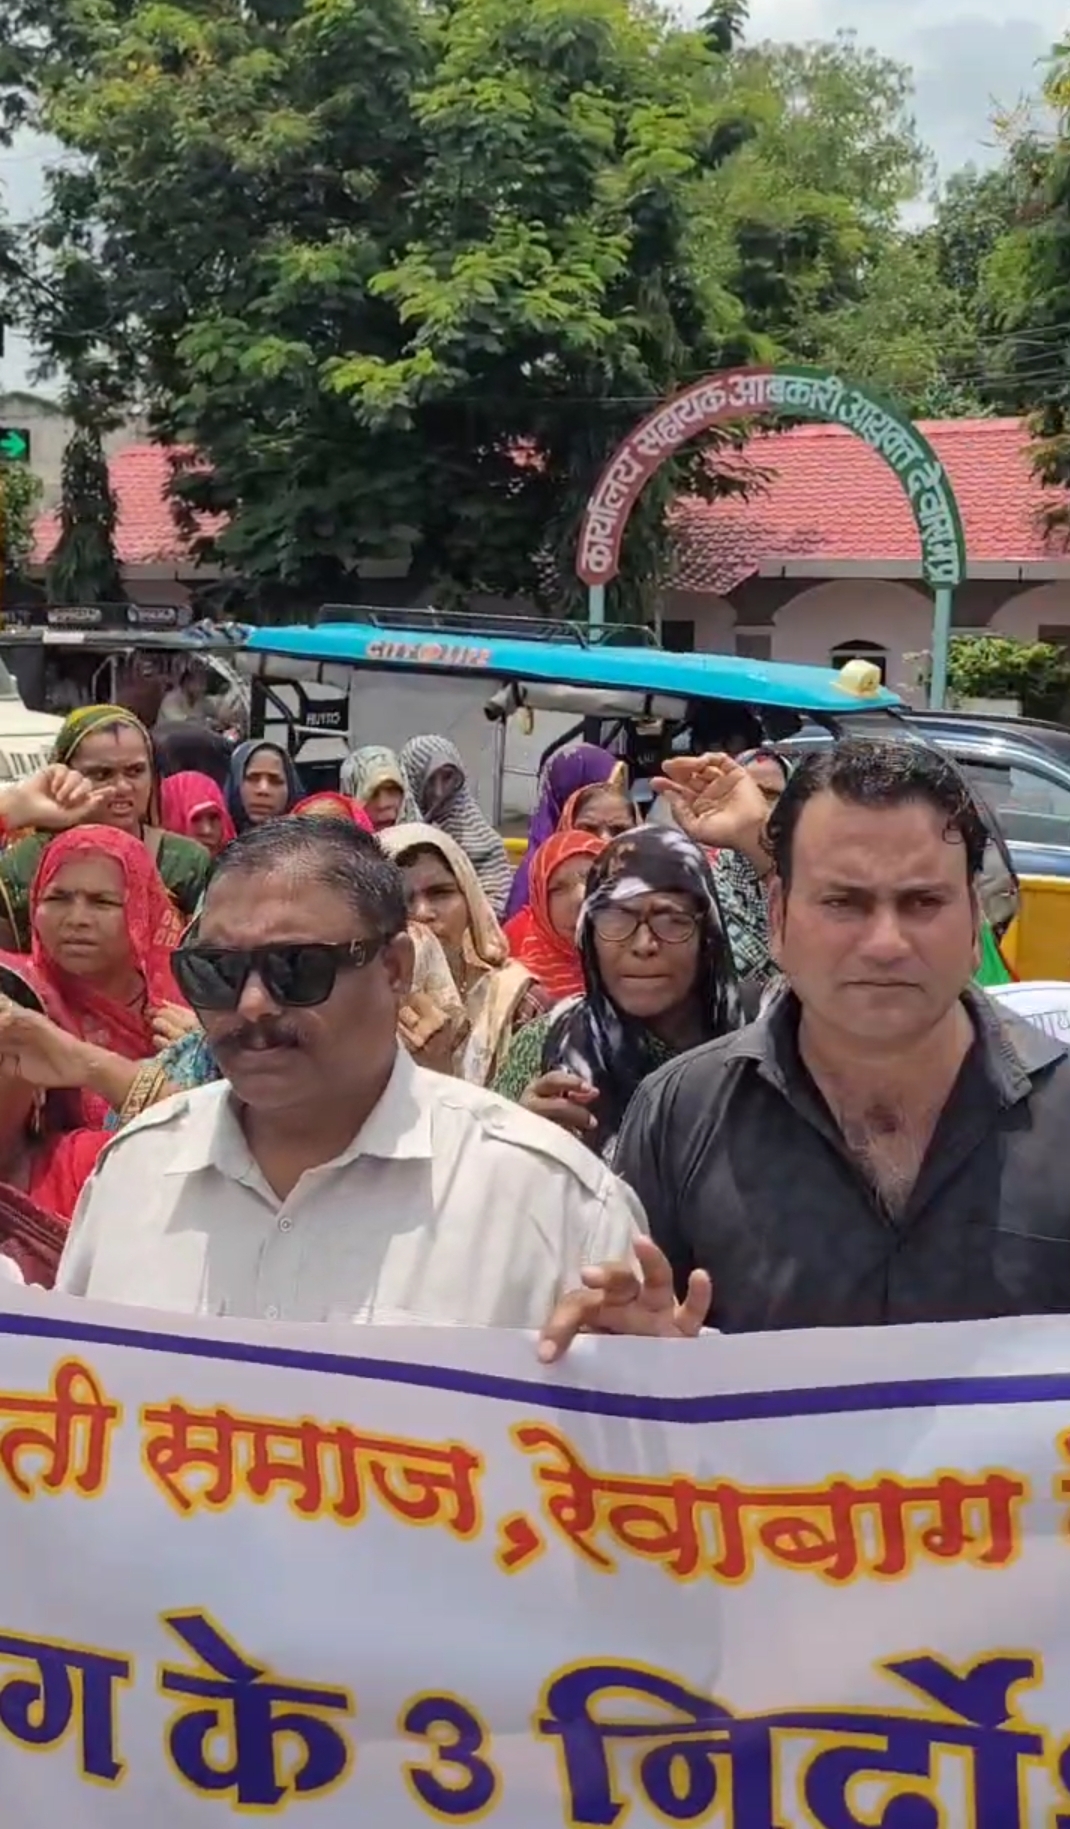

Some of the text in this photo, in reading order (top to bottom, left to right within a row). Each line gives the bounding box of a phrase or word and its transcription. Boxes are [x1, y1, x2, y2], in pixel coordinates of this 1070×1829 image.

[581, 447, 644, 573] कार्यालय
[632, 381, 726, 455] सहायक
[729, 375, 843, 415] आबकारी
[159, 1602, 350, 1809] के
[535, 1653, 1070, 1829] निर्दो
